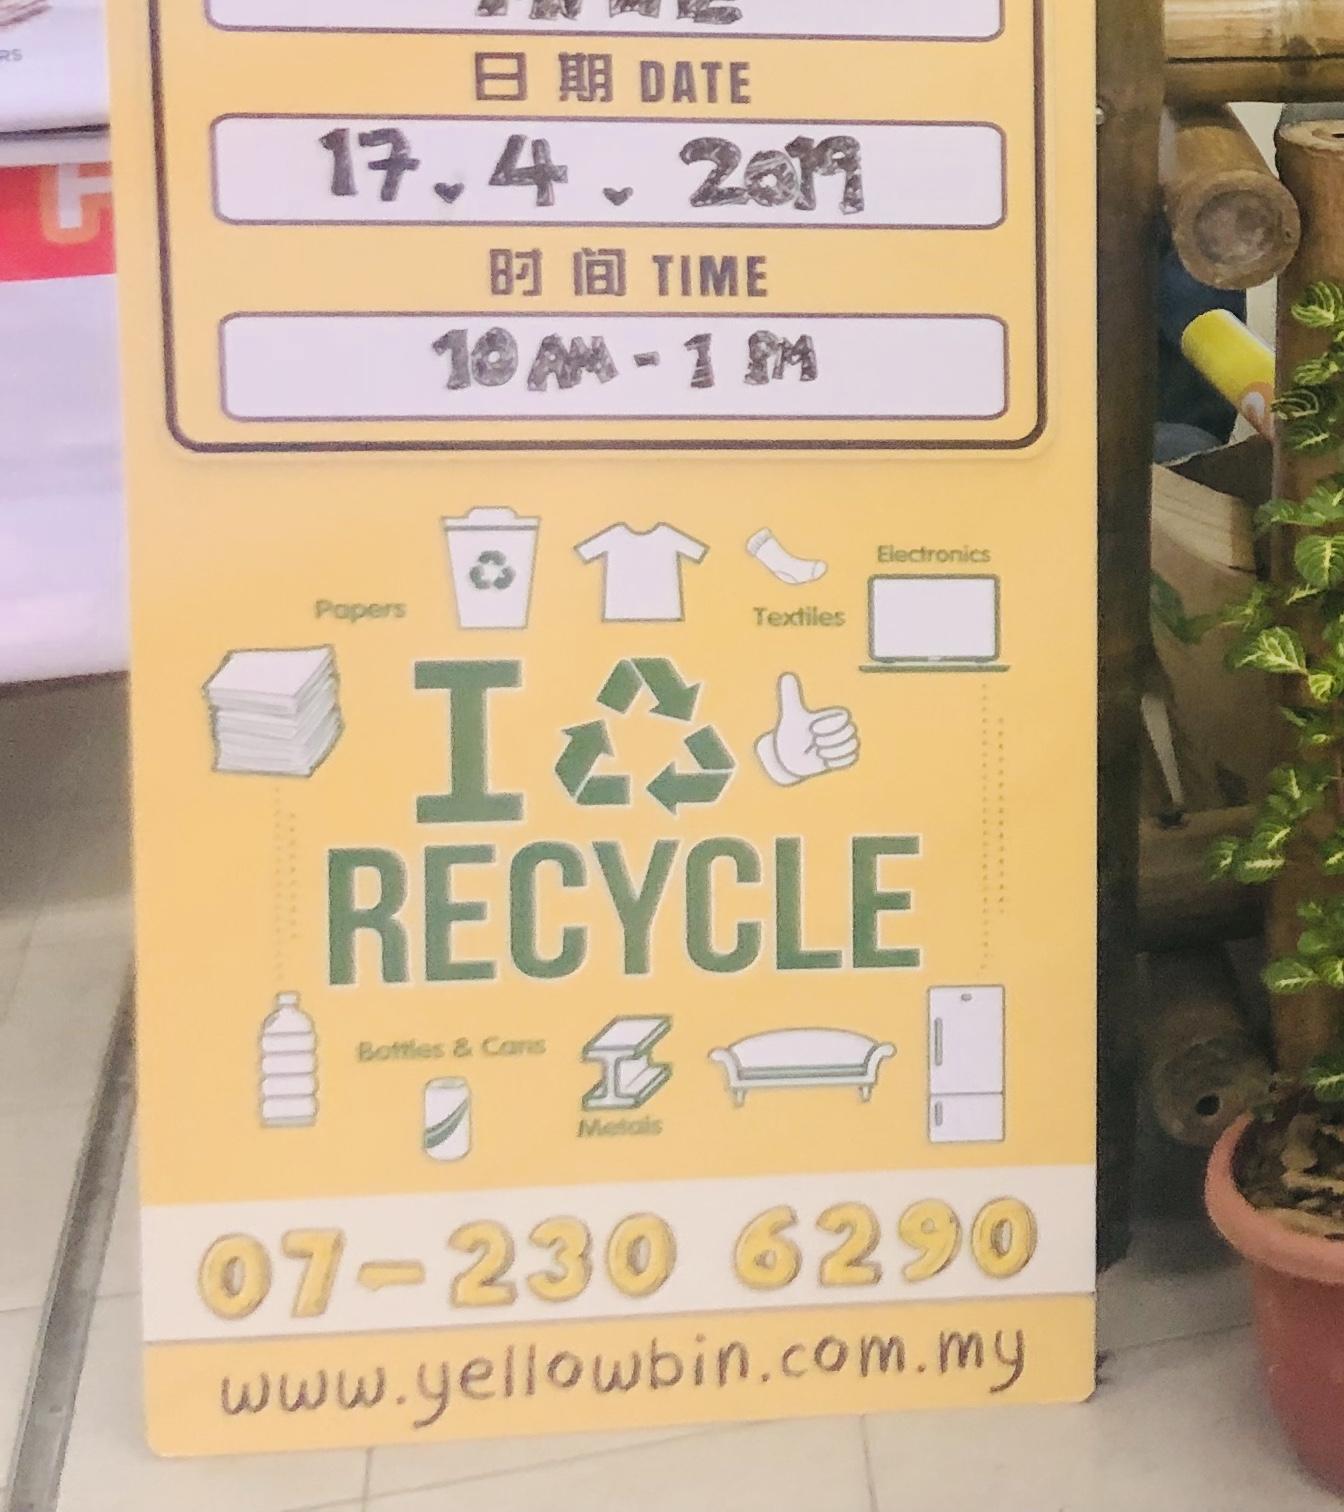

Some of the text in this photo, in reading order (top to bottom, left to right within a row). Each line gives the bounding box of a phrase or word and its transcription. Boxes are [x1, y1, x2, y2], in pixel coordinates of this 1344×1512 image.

[474, 52, 752, 104] 日期 DATE
[679, 134, 866, 215] 2019
[490, 248, 768, 299] 时间 TIME
[876, 544, 991, 565] Electronics
[315, 599, 406, 622] Papers
[753, 605, 845, 628] Textiles
[414, 659, 523, 825] I
[327, 835, 922, 987] RECYCLE
[357, 1034, 546, 1063] Bottles & Cans
[578, 1115, 663, 1140] Metals
[199, 1194, 1037, 1320] 07-230 6290
[221, 1325, 1027, 1429] www.yellowbin.com.my
